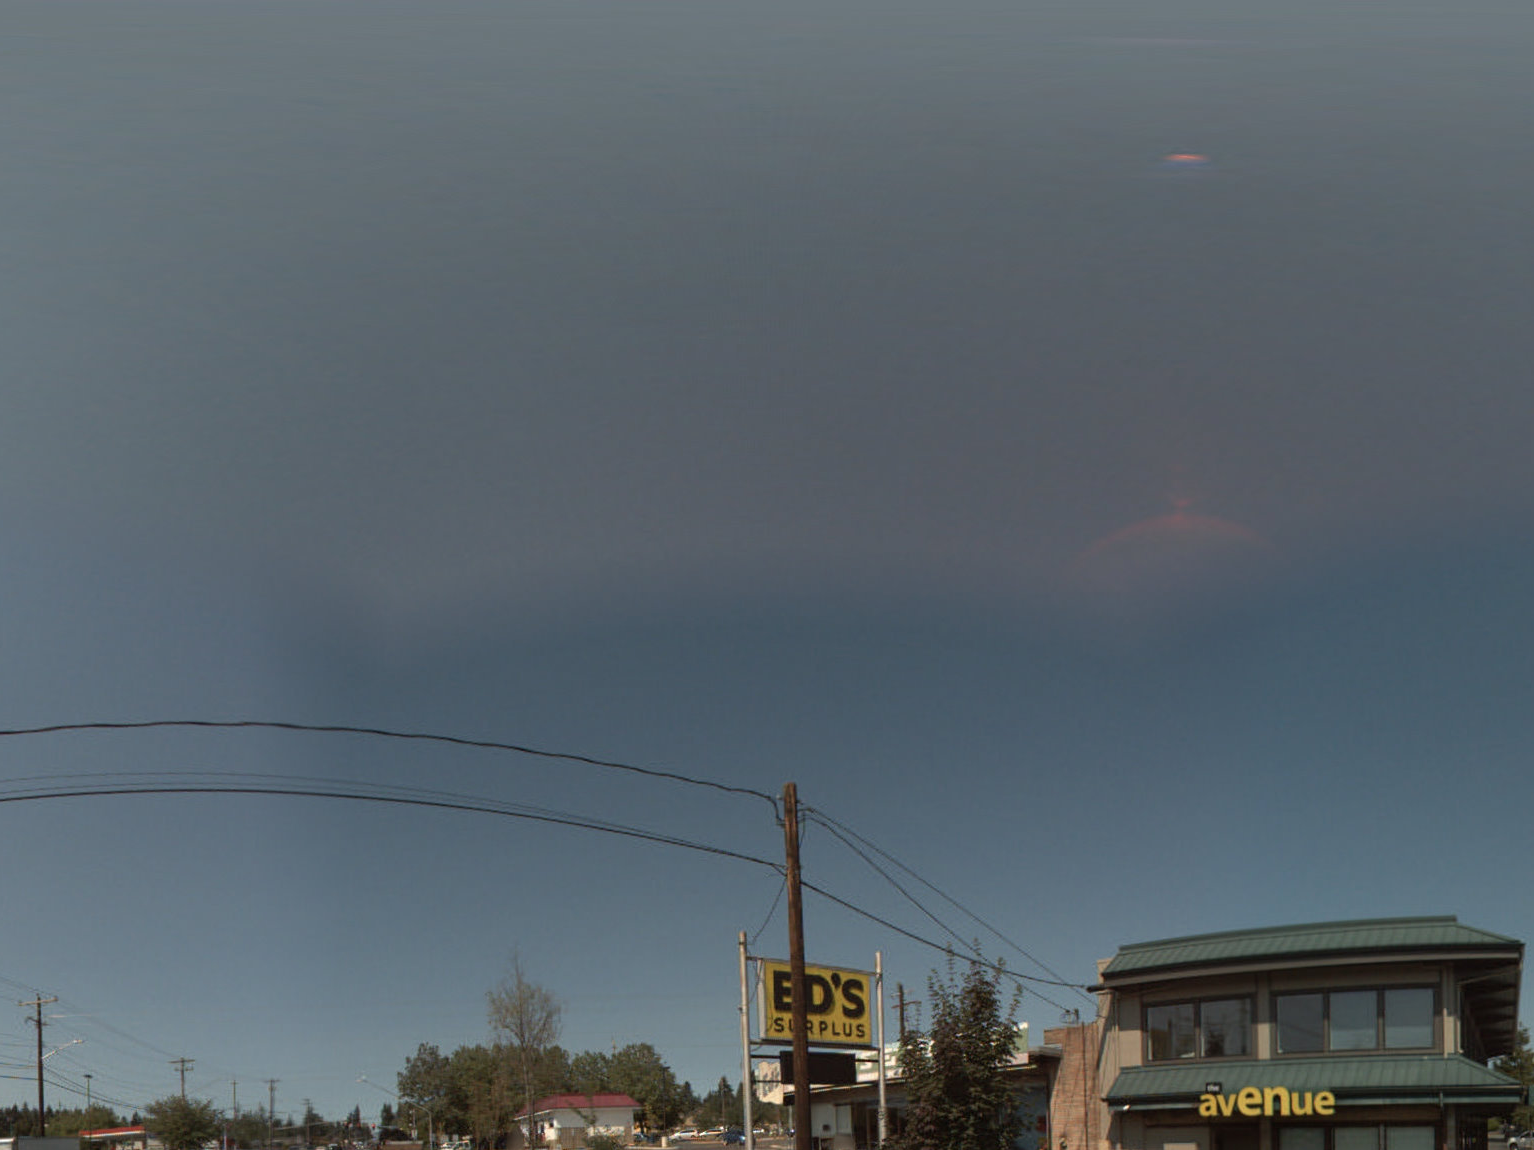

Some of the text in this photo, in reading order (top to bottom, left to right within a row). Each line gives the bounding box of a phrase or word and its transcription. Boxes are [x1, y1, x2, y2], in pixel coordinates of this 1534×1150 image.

[773, 970, 865, 1019] ED'S
[773, 1017, 865, 1038] SURPLUS
[1207, 1083, 1220, 1091] the
[1199, 1086, 1335, 1117] avenue
